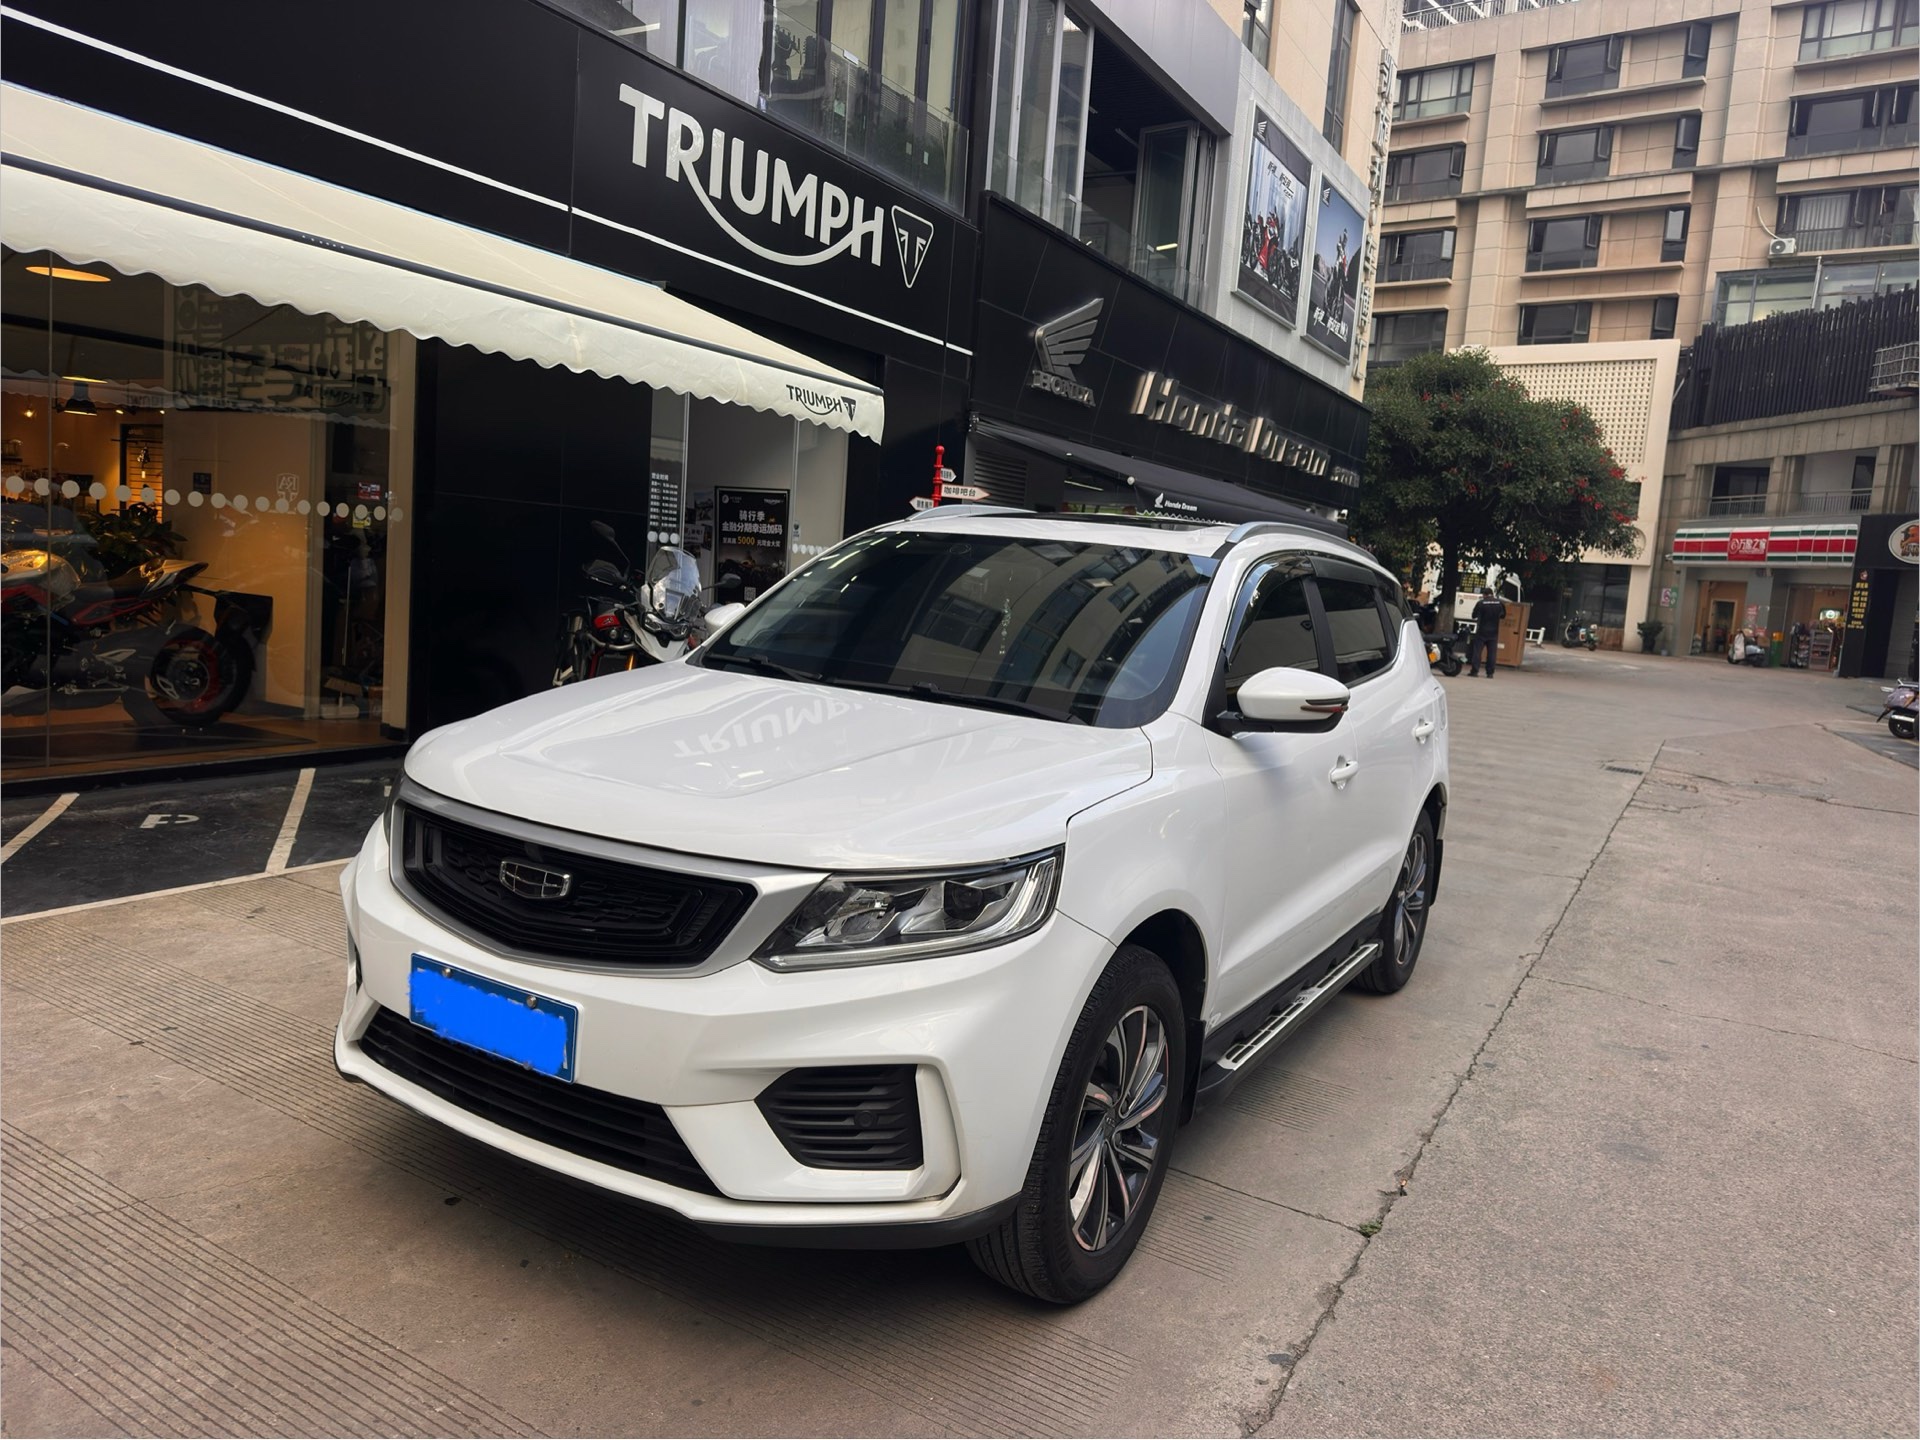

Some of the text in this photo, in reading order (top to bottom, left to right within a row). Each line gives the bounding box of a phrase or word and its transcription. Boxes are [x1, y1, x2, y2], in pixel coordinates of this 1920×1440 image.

[619, 83, 884, 266] TRIUMPH
[786, 384, 842, 415] TRIUMPH
[1131, 371, 1248, 447] Honda
[944, 486, 976, 497] 咖啡吧台
[737, 536, 755, 545] 5000
